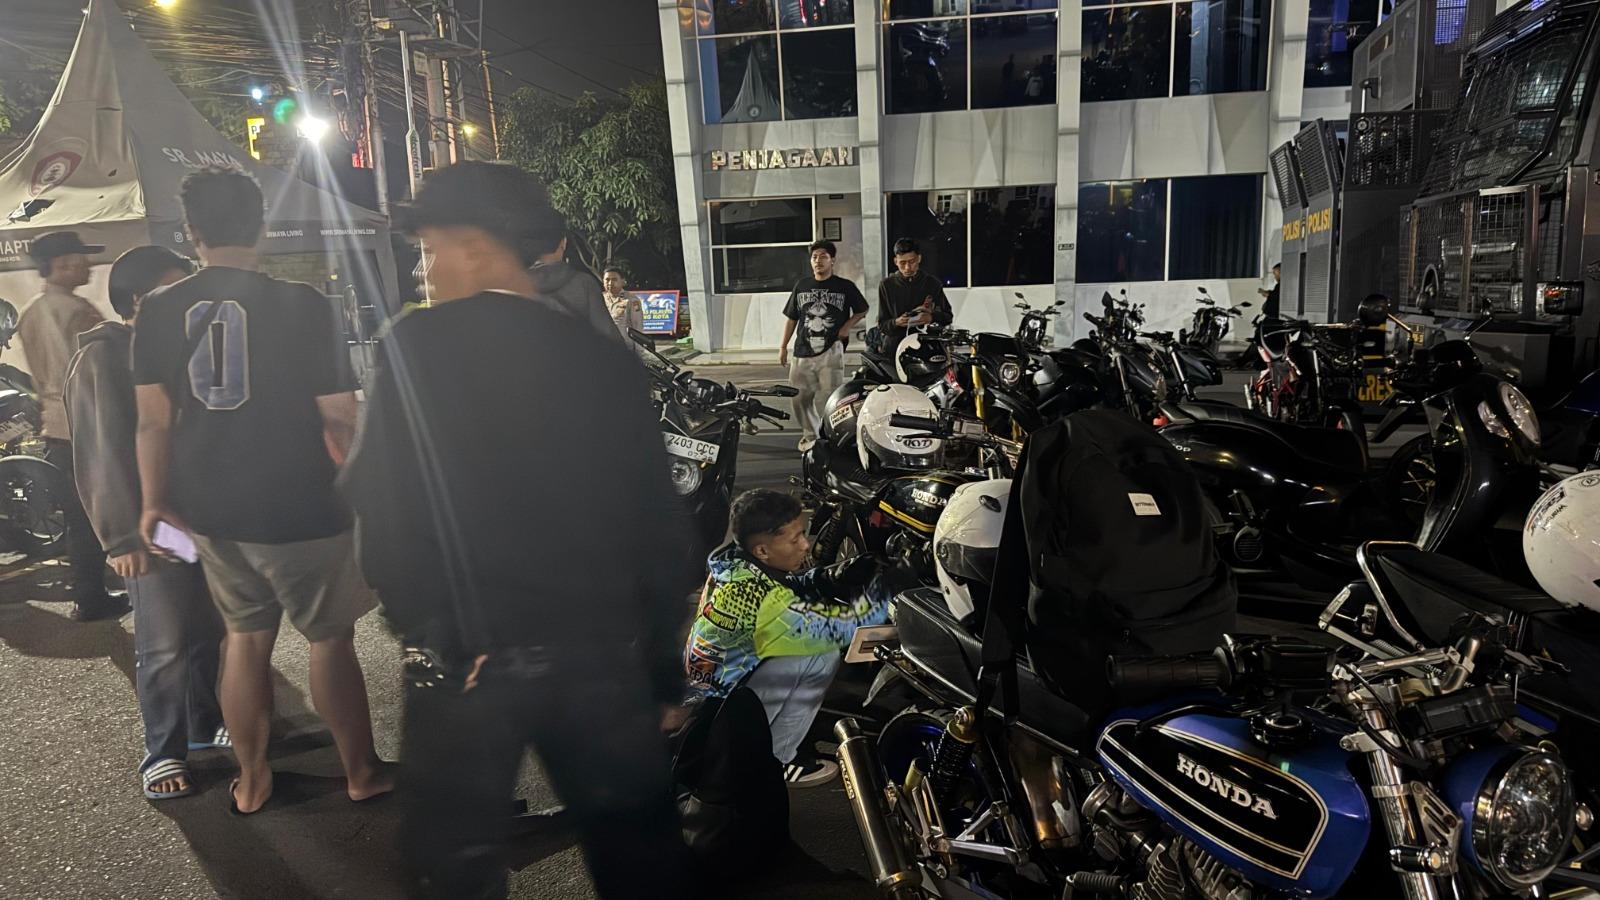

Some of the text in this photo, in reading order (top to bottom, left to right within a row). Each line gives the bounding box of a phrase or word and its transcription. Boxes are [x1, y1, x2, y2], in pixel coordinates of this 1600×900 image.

[711, 147, 853, 170] PENJAGAAN
[1282, 220, 1300, 241] POLISI
[1308, 208, 1330, 234] POLISI
[667, 435, 715, 456] 2403 CCC
[907, 438, 929, 447] KYT
[911, 488, 947, 506] HONDA
[1176, 752, 1280, 820] HONDA
